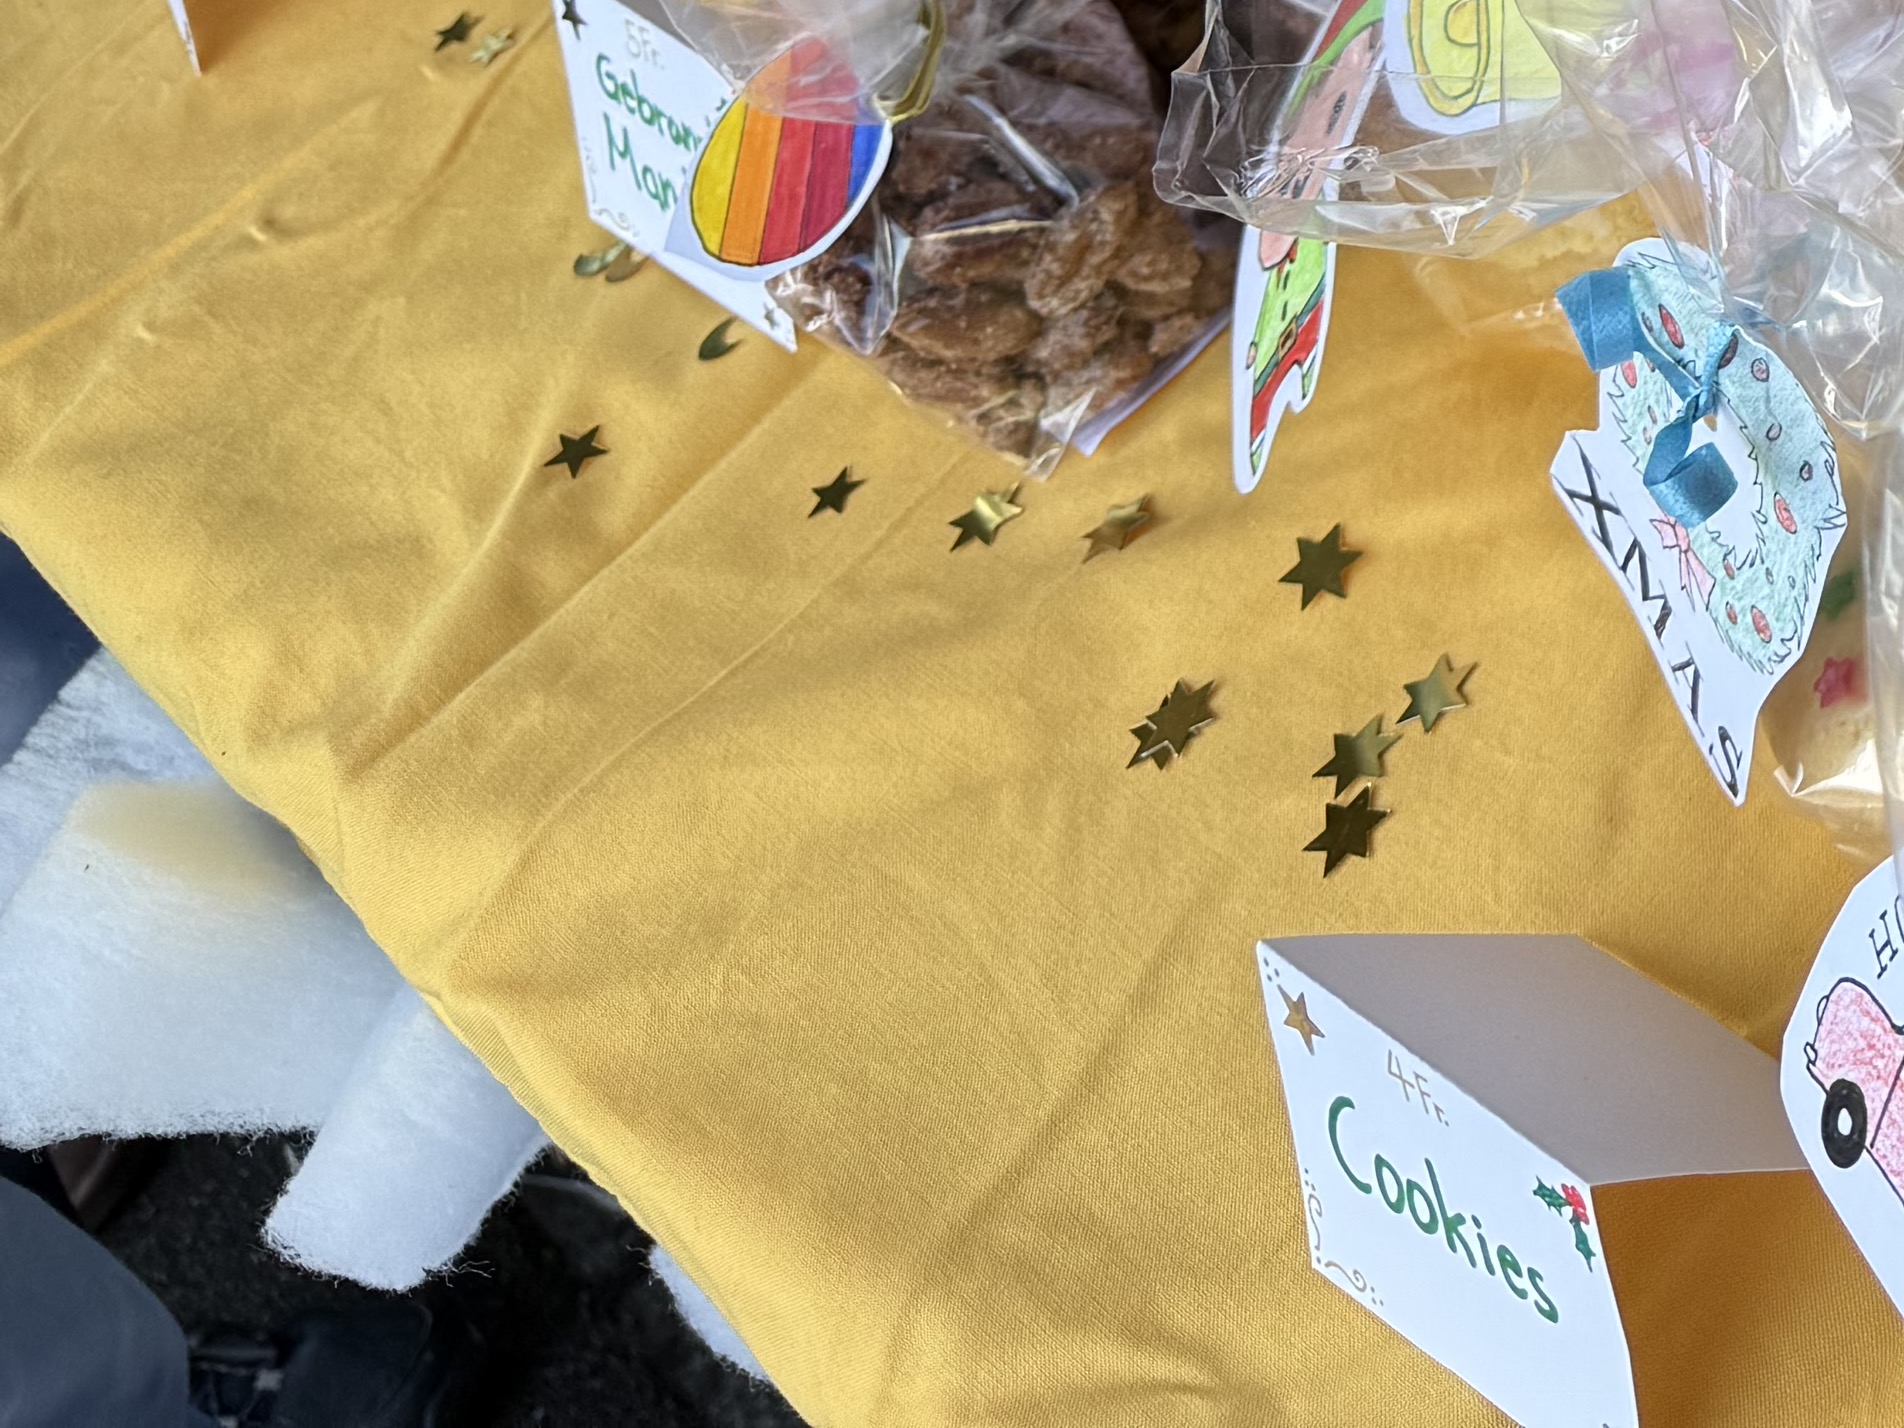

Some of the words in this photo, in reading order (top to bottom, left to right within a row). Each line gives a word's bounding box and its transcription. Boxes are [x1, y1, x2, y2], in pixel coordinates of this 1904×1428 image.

[595, 52, 711, 152] Gebran
[603, 111, 687, 211] Man
[1326, 1094, 1560, 1325] Cookies
